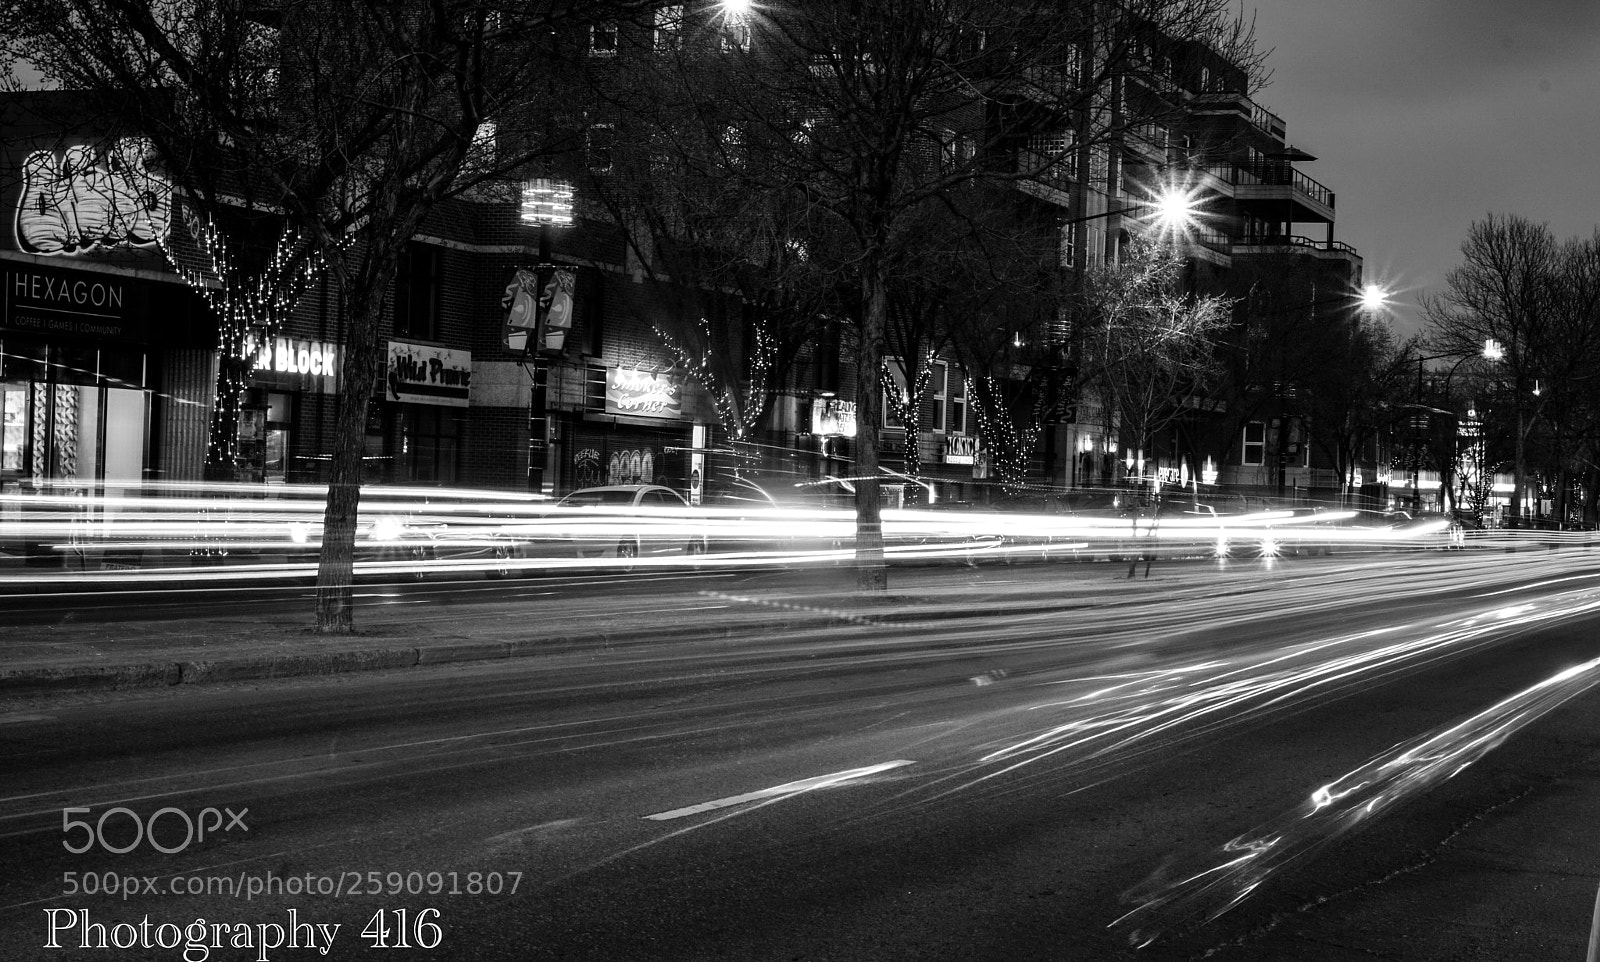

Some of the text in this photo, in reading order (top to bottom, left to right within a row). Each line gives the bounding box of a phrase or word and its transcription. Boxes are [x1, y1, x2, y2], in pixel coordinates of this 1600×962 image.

[15, 272, 122, 308] HEXAGON
[15, 316, 122, 336] COFFEE GAMES COMMUNITY
[275, 343, 335, 377] BLOCK
[617, 393, 668, 414] Corner
[947, 436, 974, 456] TOKYO
